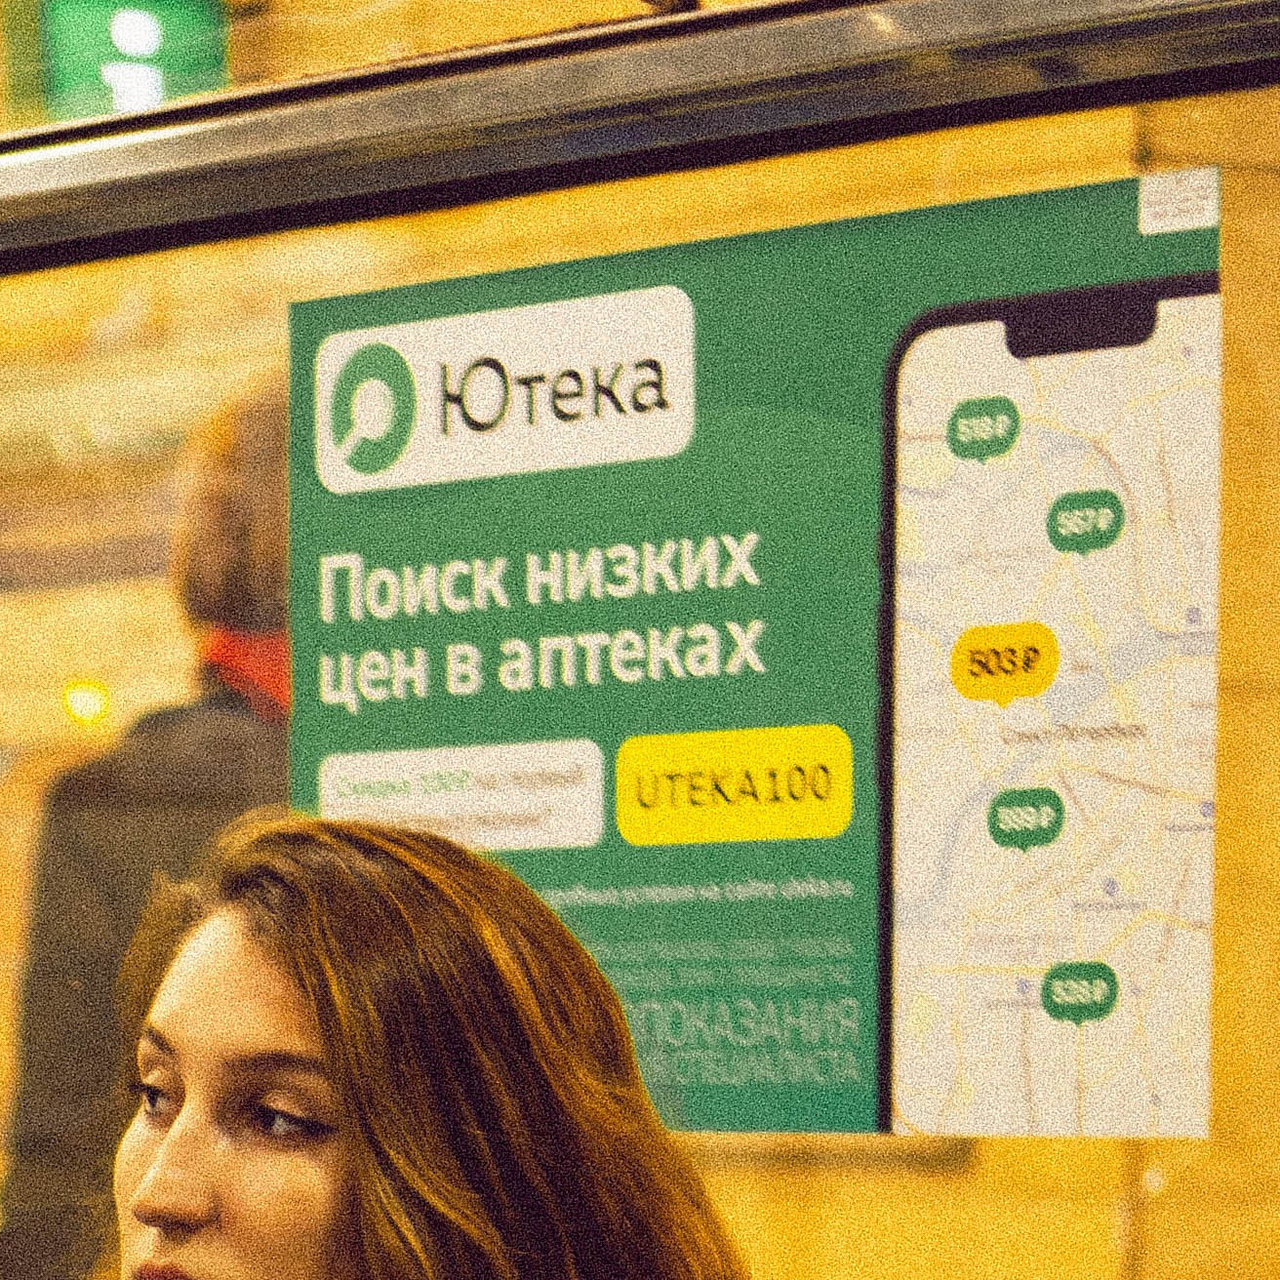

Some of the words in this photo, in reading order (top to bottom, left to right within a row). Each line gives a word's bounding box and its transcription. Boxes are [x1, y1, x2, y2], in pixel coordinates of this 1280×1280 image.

[439, 355, 670, 435] Ютека
[319, 552, 511, 624] Поиск
[526, 531, 762, 605] низких
[320, 645, 428, 715] цен
[446, 641, 483, 696] в
[497, 619, 767, 692] аптеках
[634, 762, 833, 811] UTEKA100
[636, 997, 861, 1047] ПОКАЗАНИЯ
